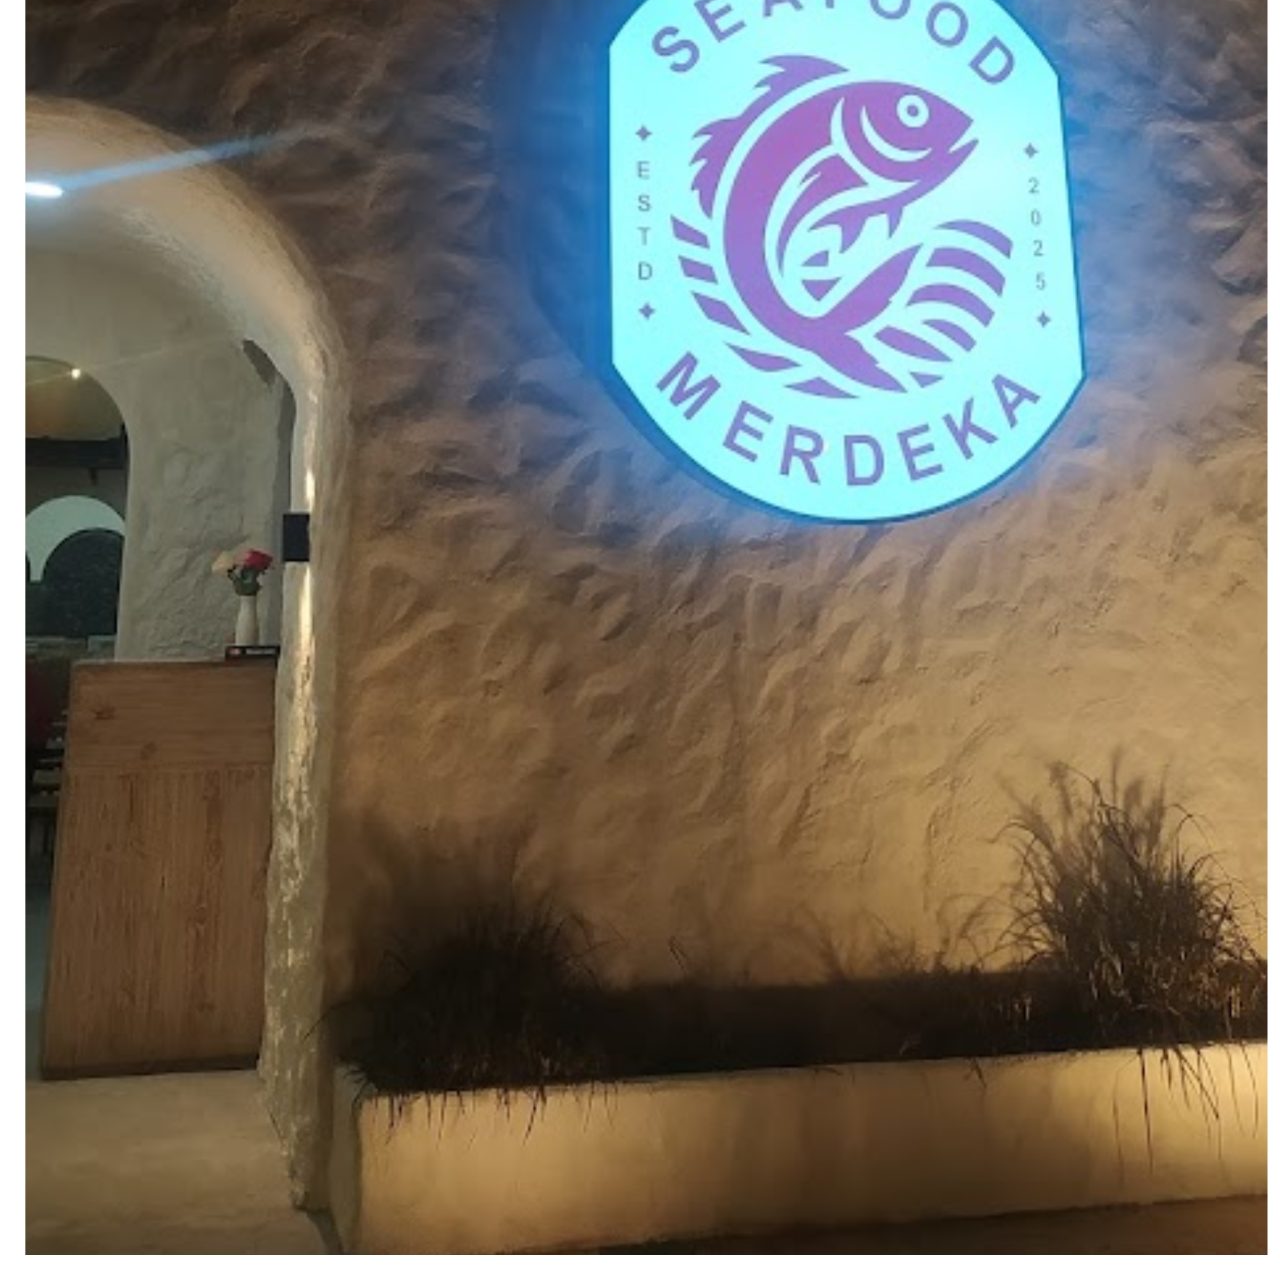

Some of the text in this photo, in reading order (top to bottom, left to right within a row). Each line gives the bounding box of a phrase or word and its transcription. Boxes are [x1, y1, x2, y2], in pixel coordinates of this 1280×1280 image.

[636, 160, 654, 282] ESTD
[1027, 177, 1047, 291] 2025
[656, 351, 1040, 487] MERDEKA
